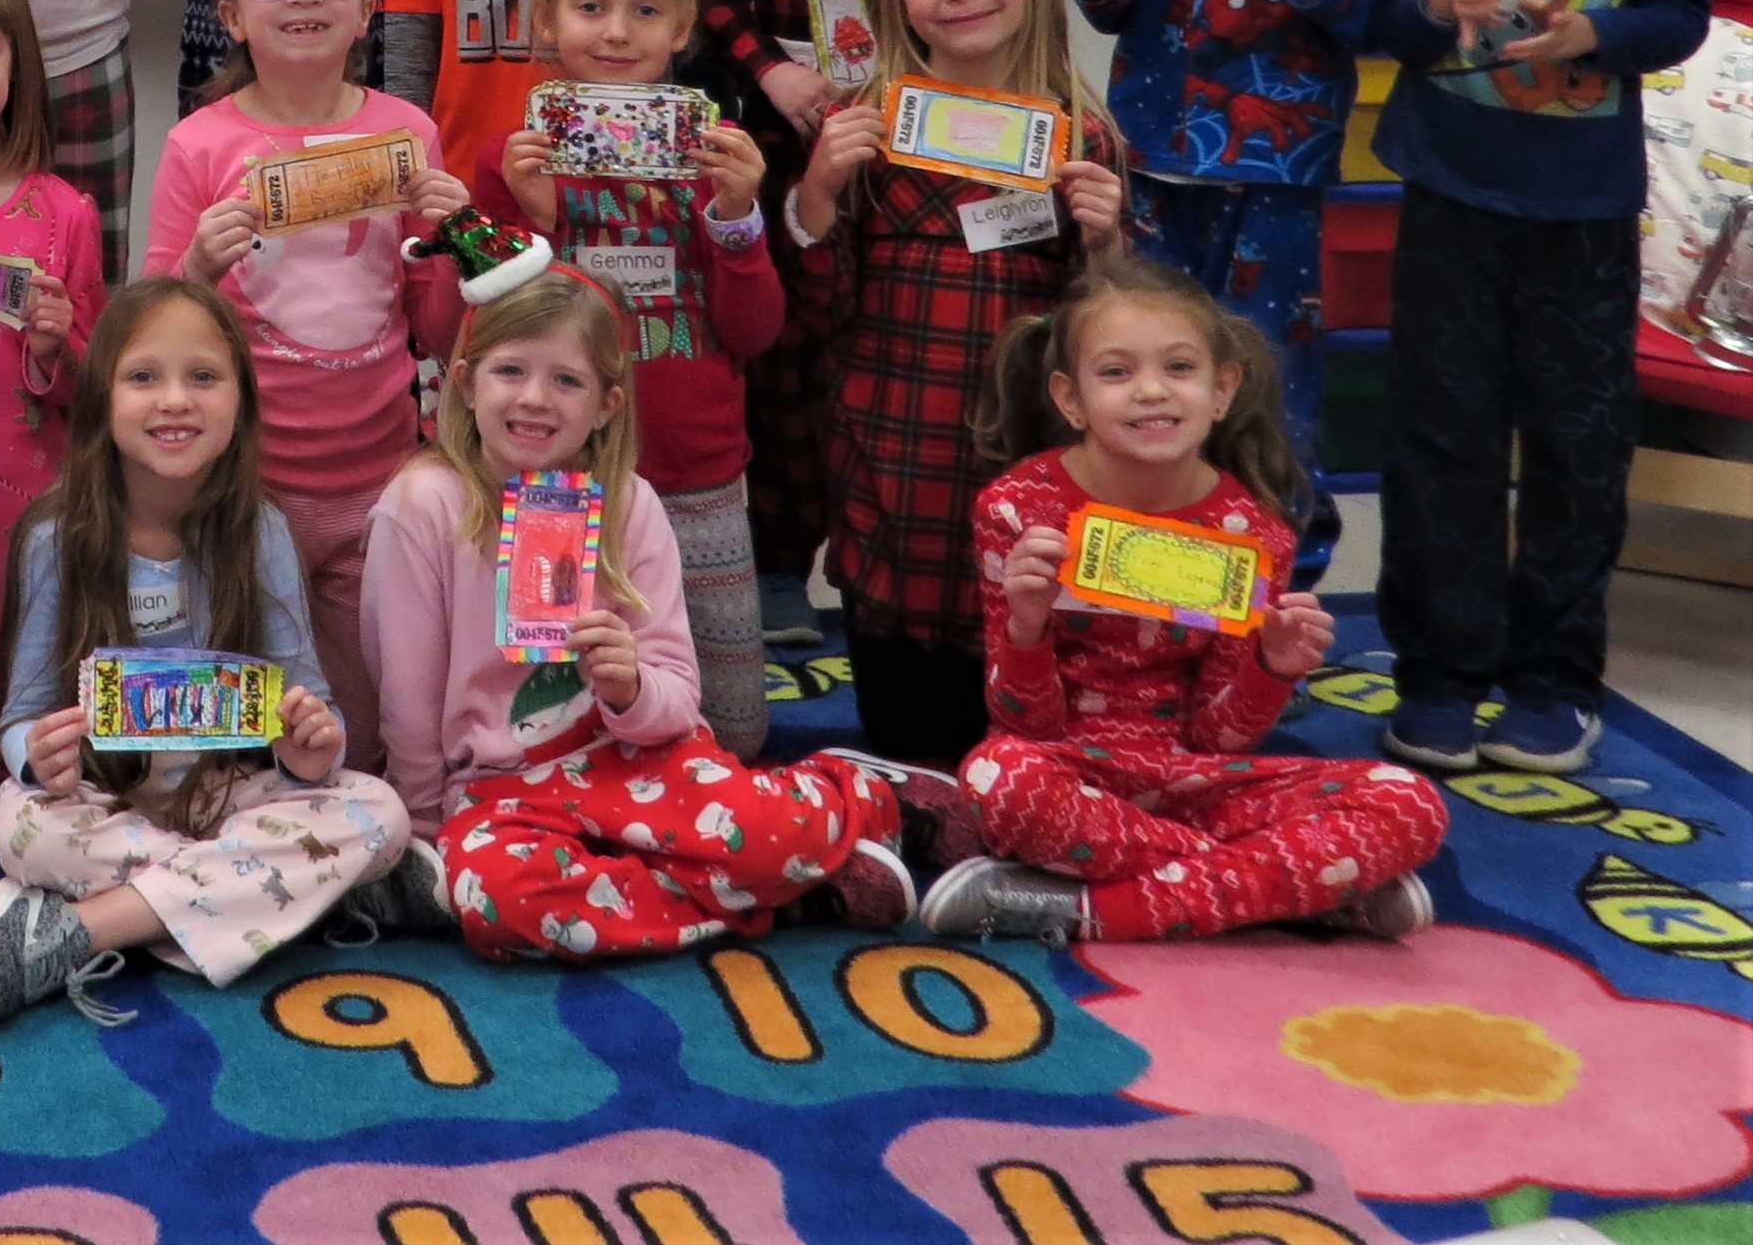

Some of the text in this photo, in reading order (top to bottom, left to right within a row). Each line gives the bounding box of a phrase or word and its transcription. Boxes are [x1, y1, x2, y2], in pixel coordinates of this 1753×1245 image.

[563, 182, 696, 226] HAPPY
[590, 252, 667, 270] Gemma
[271, 968, 493, 1090] 9
[702, 942, 1057, 1065] 10
